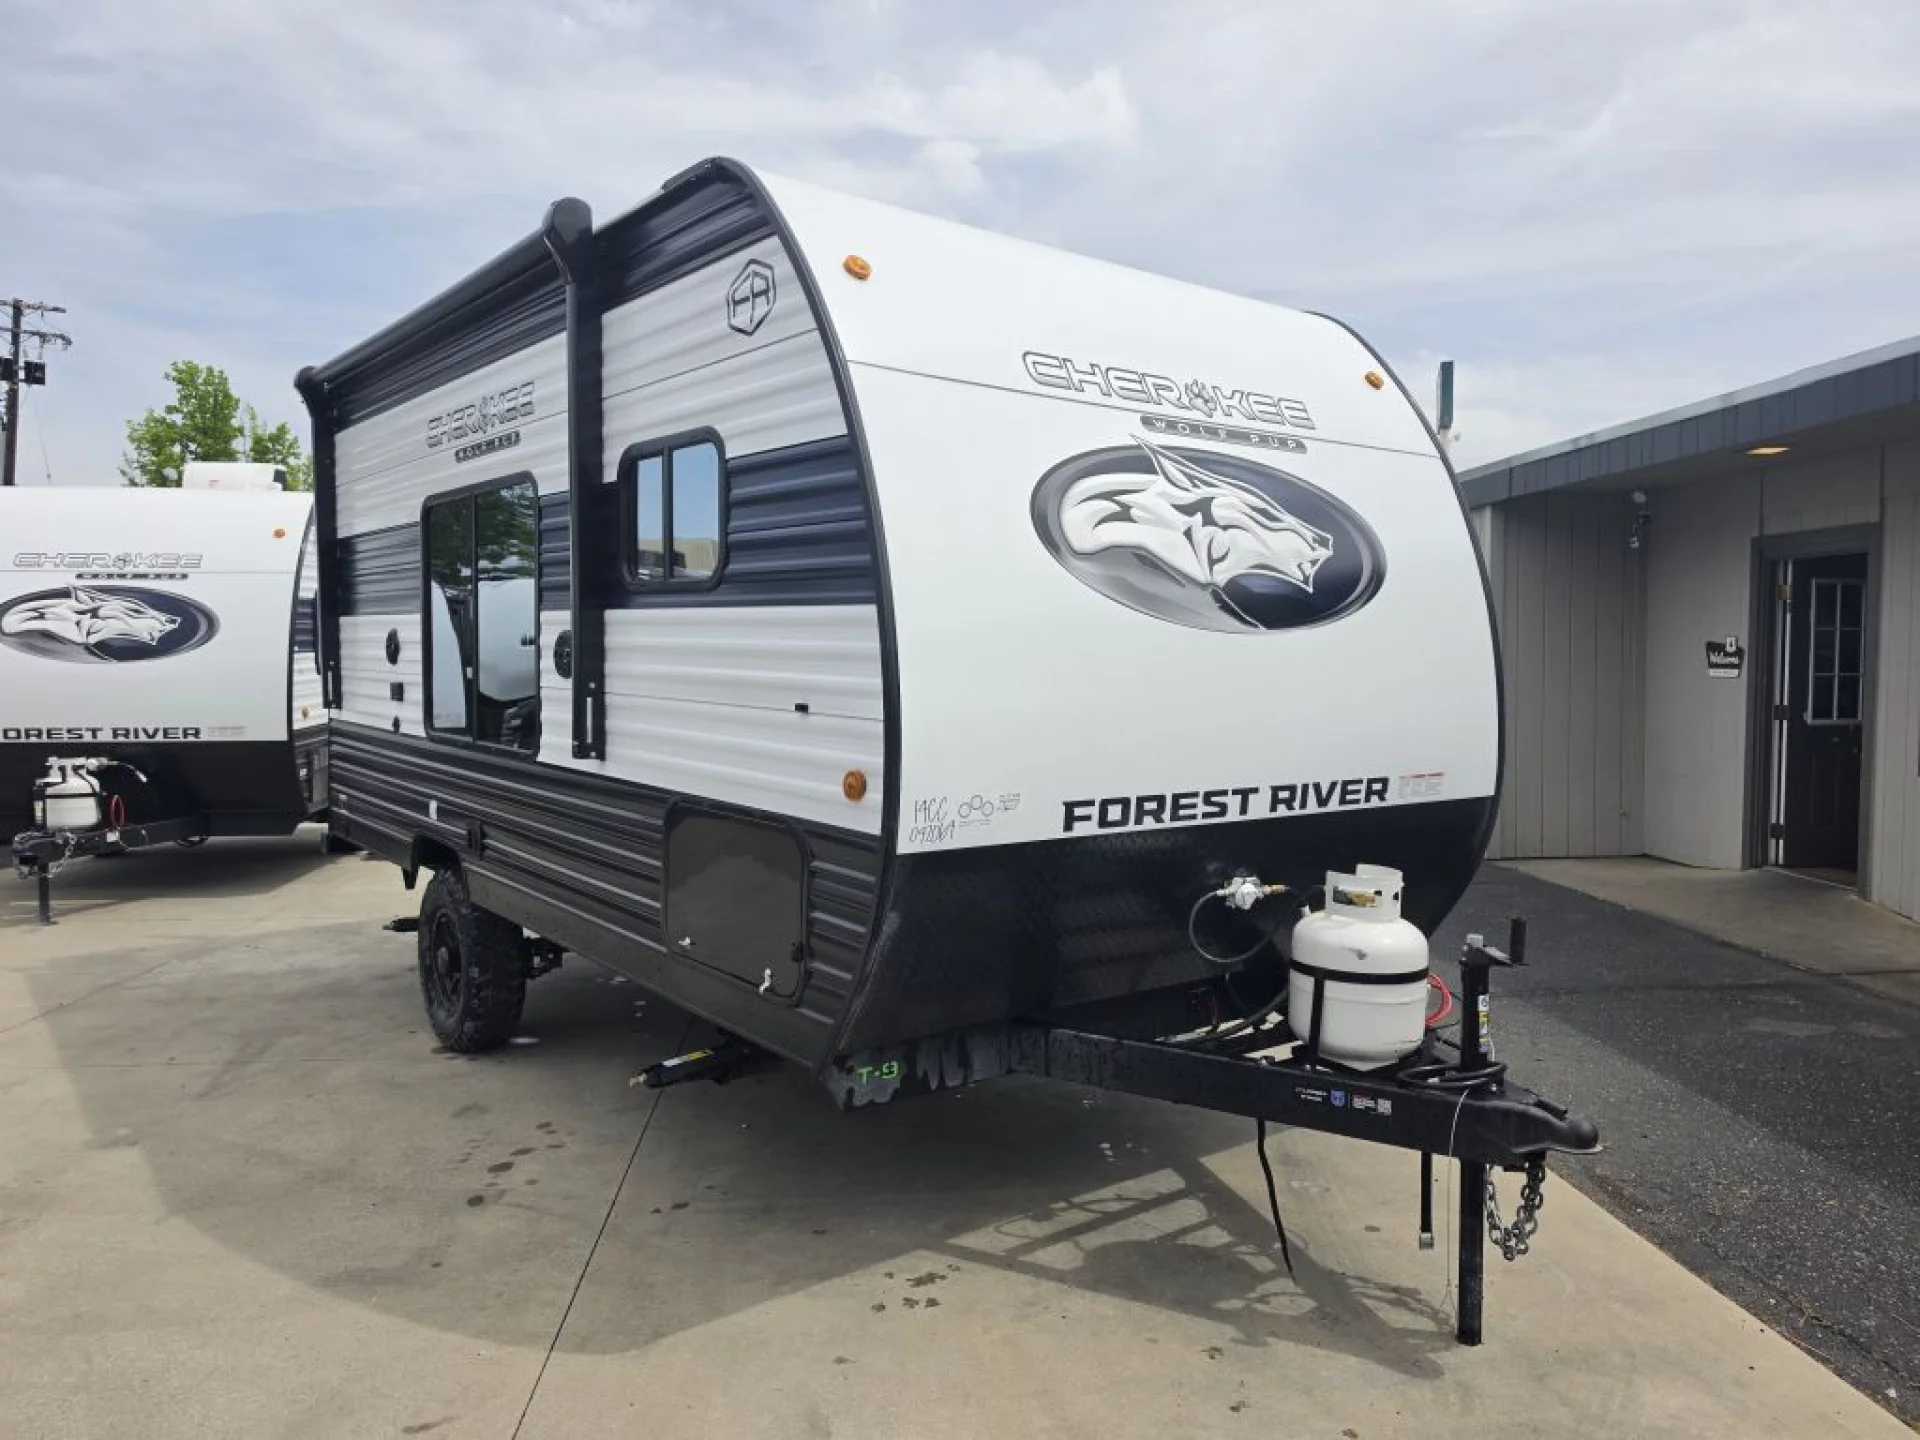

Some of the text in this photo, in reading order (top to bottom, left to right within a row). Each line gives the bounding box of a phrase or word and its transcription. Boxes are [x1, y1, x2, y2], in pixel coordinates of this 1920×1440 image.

[2, 727, 103, 740] OREST
[111, 727, 201, 740] RIVER
[1062, 786, 1260, 833] FOREST
[1268, 776, 1389, 813] RIVER
